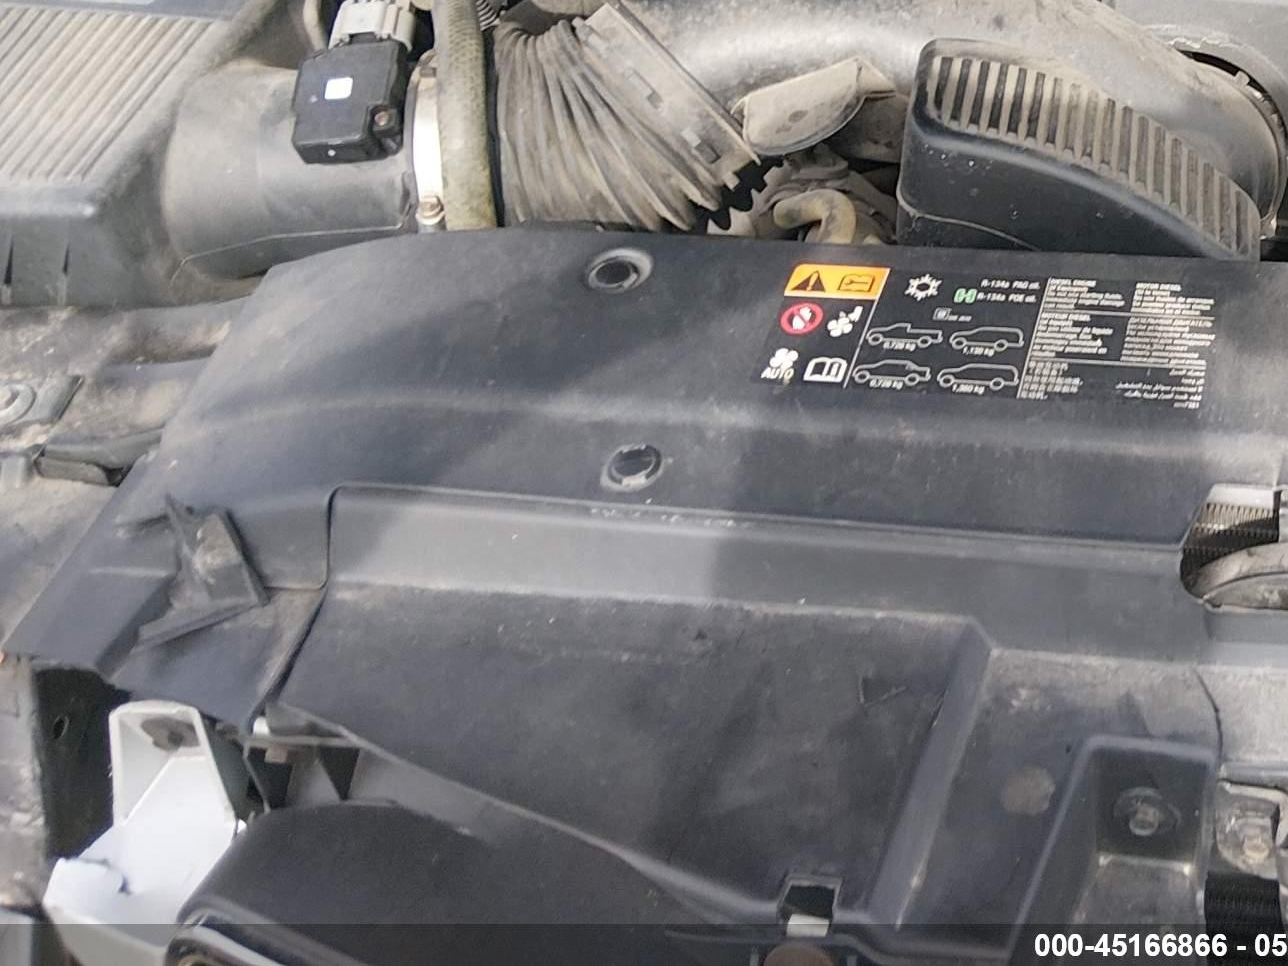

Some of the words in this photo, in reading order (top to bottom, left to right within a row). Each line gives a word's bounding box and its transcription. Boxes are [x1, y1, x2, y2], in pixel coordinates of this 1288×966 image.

[981, 278, 1010, 289] R-134a
[976, 291, 1006, 302] R-134a
[760, 366, 795, 380] AUTO
